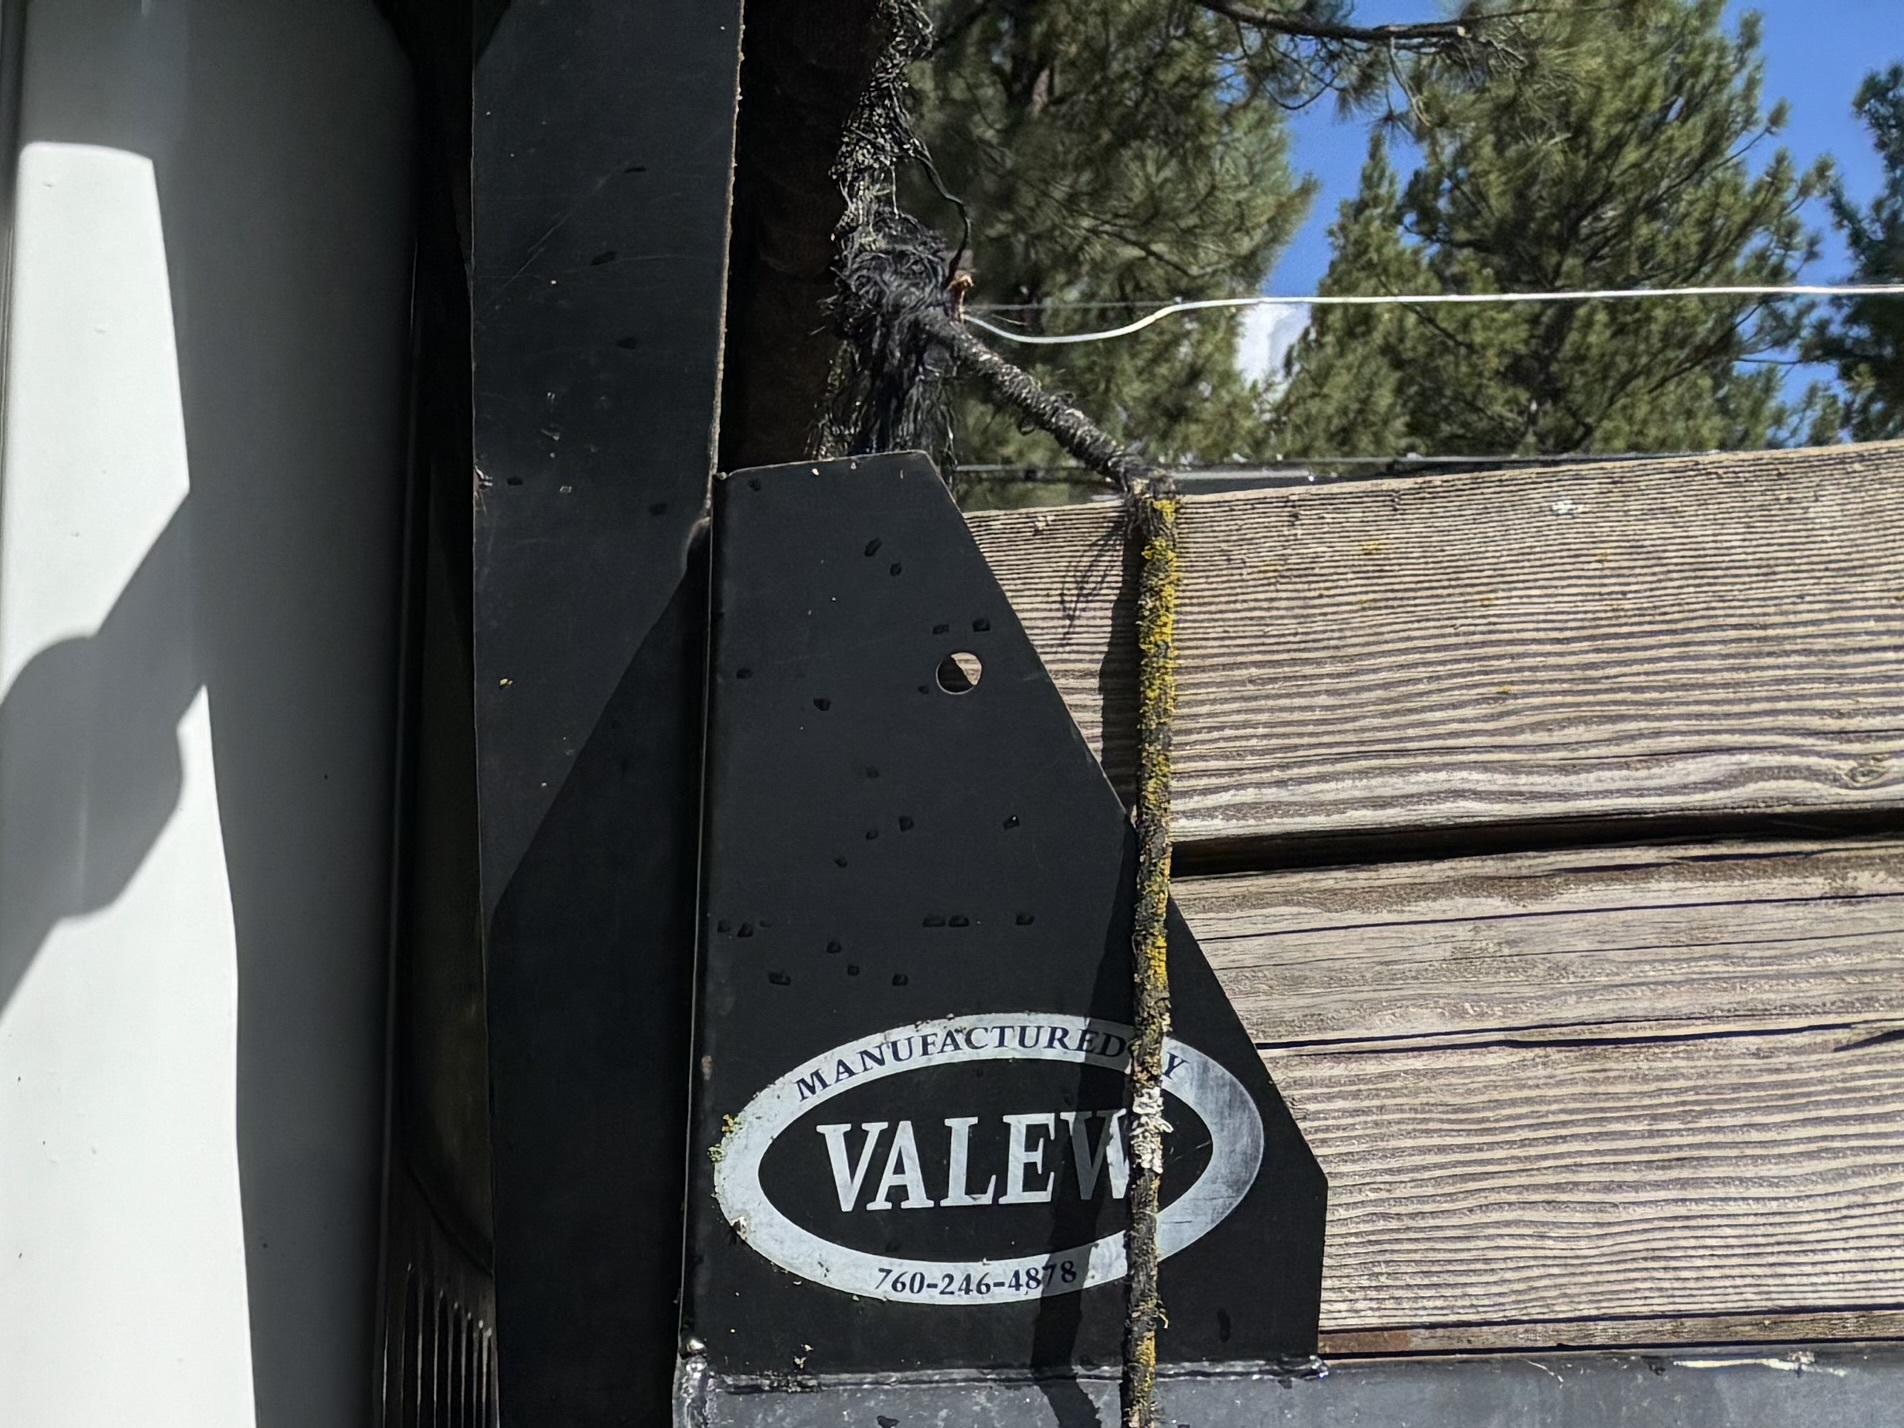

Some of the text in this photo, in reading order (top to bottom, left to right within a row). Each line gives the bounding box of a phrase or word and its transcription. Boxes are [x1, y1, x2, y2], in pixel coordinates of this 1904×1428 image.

[795, 1025, 1127, 1100] MANUFACTURED
[815, 1107, 1130, 1212] VALEW
[876, 1259, 1078, 1297] 760-246-4878
